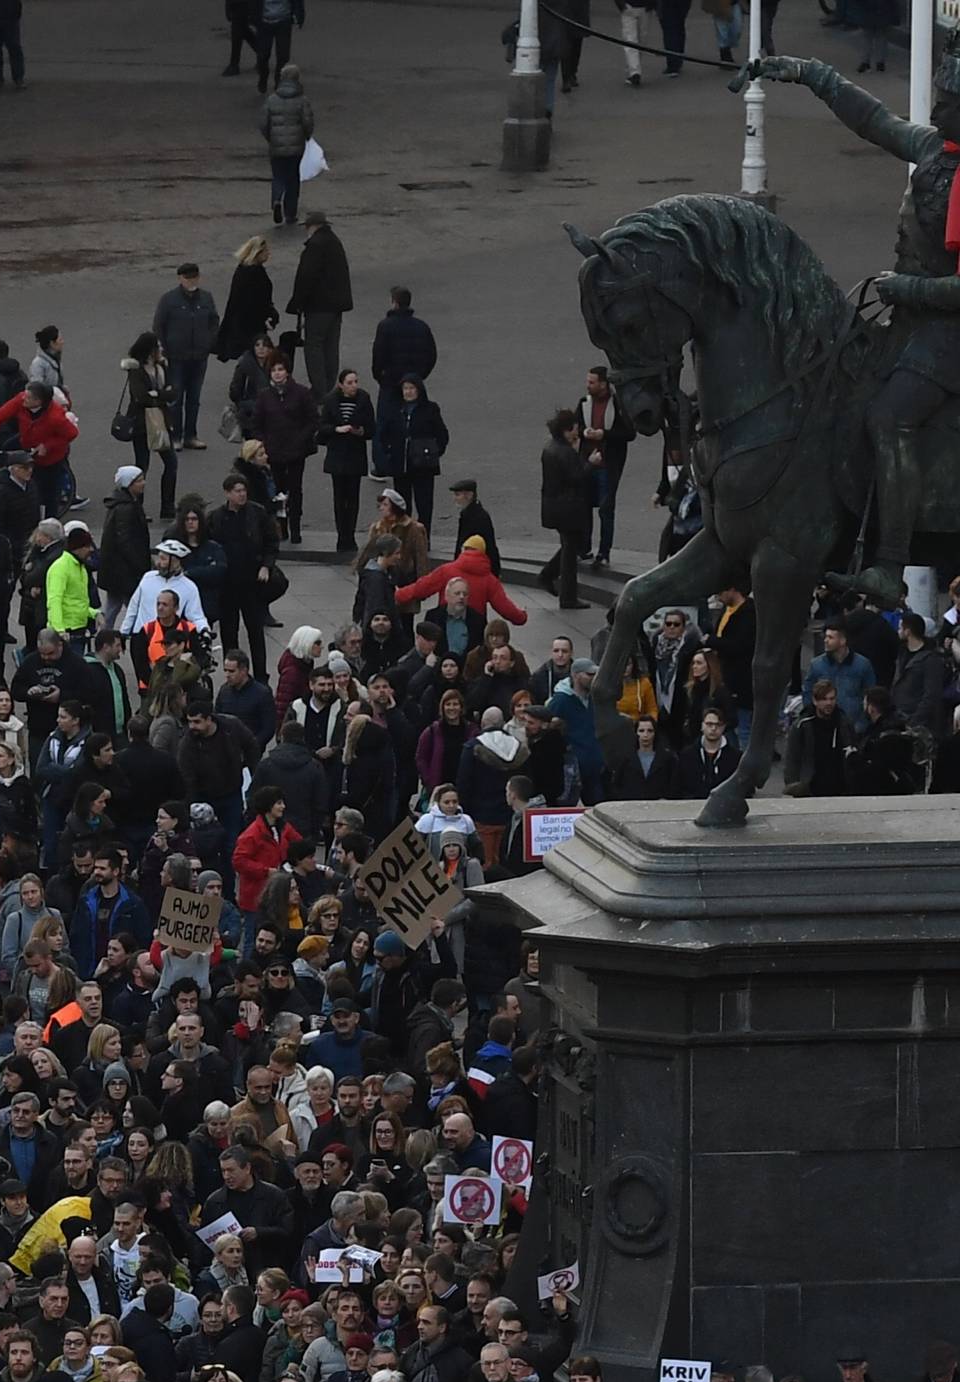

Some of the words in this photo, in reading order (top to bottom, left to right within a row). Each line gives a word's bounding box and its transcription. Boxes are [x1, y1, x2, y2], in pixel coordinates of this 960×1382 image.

[365, 829, 425, 899] DOLE
[173, 897, 210, 920] AJMO
[383, 861, 449, 933] MILE
[159, 916, 215, 944] PURGERI
[662, 1365, 708, 1380] KRIV
